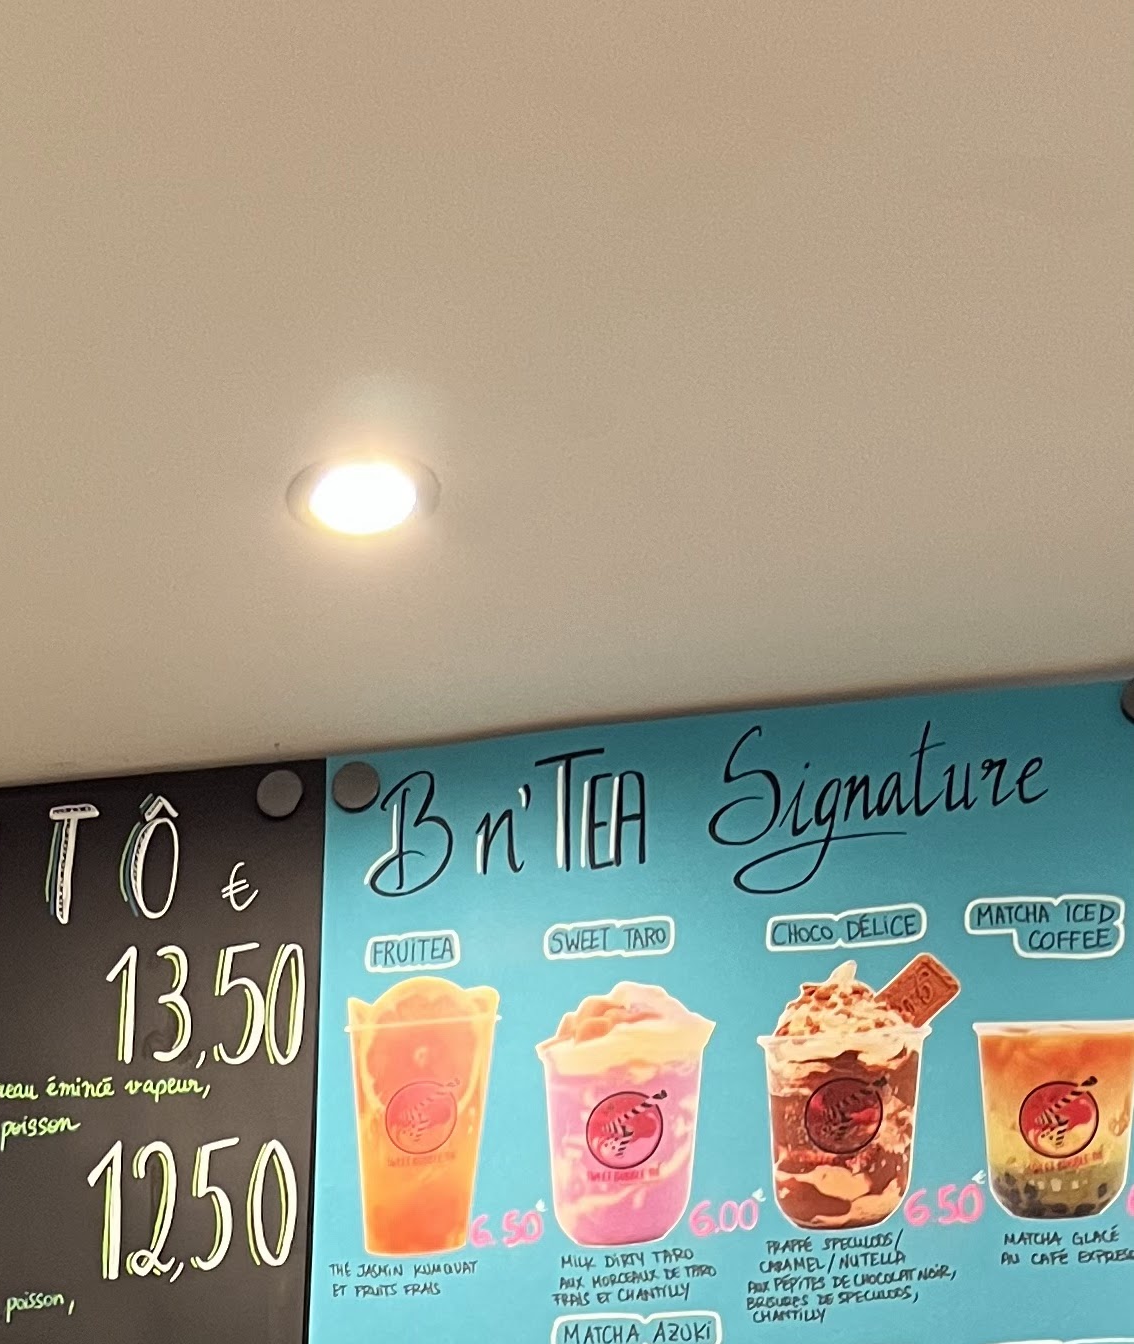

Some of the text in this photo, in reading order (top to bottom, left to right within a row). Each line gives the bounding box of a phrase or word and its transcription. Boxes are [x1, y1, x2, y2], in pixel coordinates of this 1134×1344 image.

[708, 721, 1049, 893] Signature
[221, 862, 259, 911] €
[977, 904, 1049, 927] MATCHA
[549, 927, 667, 954] SWEET TARO
[771, 923, 834, 945] CHOCO
[1028, 929, 1113, 950] COFFEE
[106, 942, 306, 1068] 13,50
[46, 1075, 114, 1097] émincé
[1, 1115, 81, 1151] poisson
[87, 1137, 297, 1283] 12,50
[689, 1200, 759, 1237] 6.00
[1003, 1225, 1119, 1246] MATCHA GLACÉ
[652, 1248, 694, 1264] TARO
[1001, 1249, 1068, 1265] AU CAFÉ
